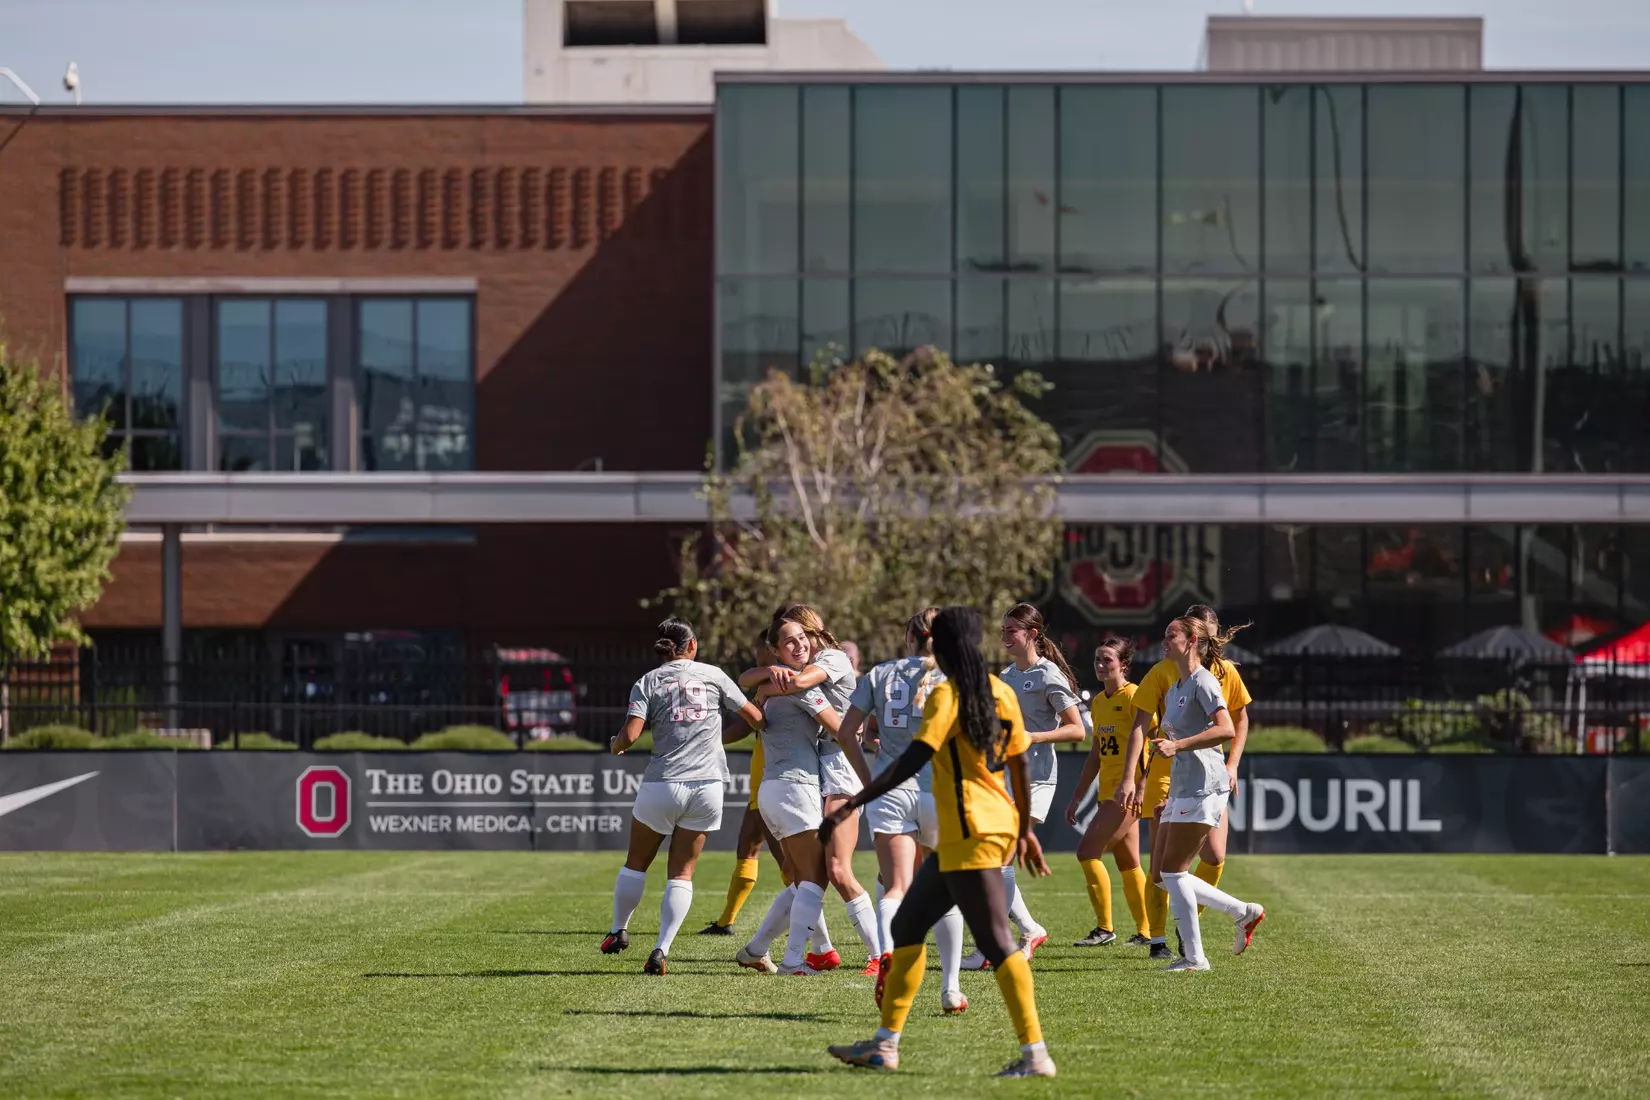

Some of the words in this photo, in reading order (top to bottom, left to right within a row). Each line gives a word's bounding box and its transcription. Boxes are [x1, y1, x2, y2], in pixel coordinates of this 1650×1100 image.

[666, 679, 709, 722] 19
[1100, 735, 1120, 756] 24
[365, 768, 424, 795] THE
[431, 768, 503, 795] OHIO
[509, 768, 595, 795] STATE
[296, 765, 351, 838] O
[1228, 778, 1443, 833] DURIL
[369, 814, 452, 833] WEXNER
[546, 814, 622, 833] CENTER
